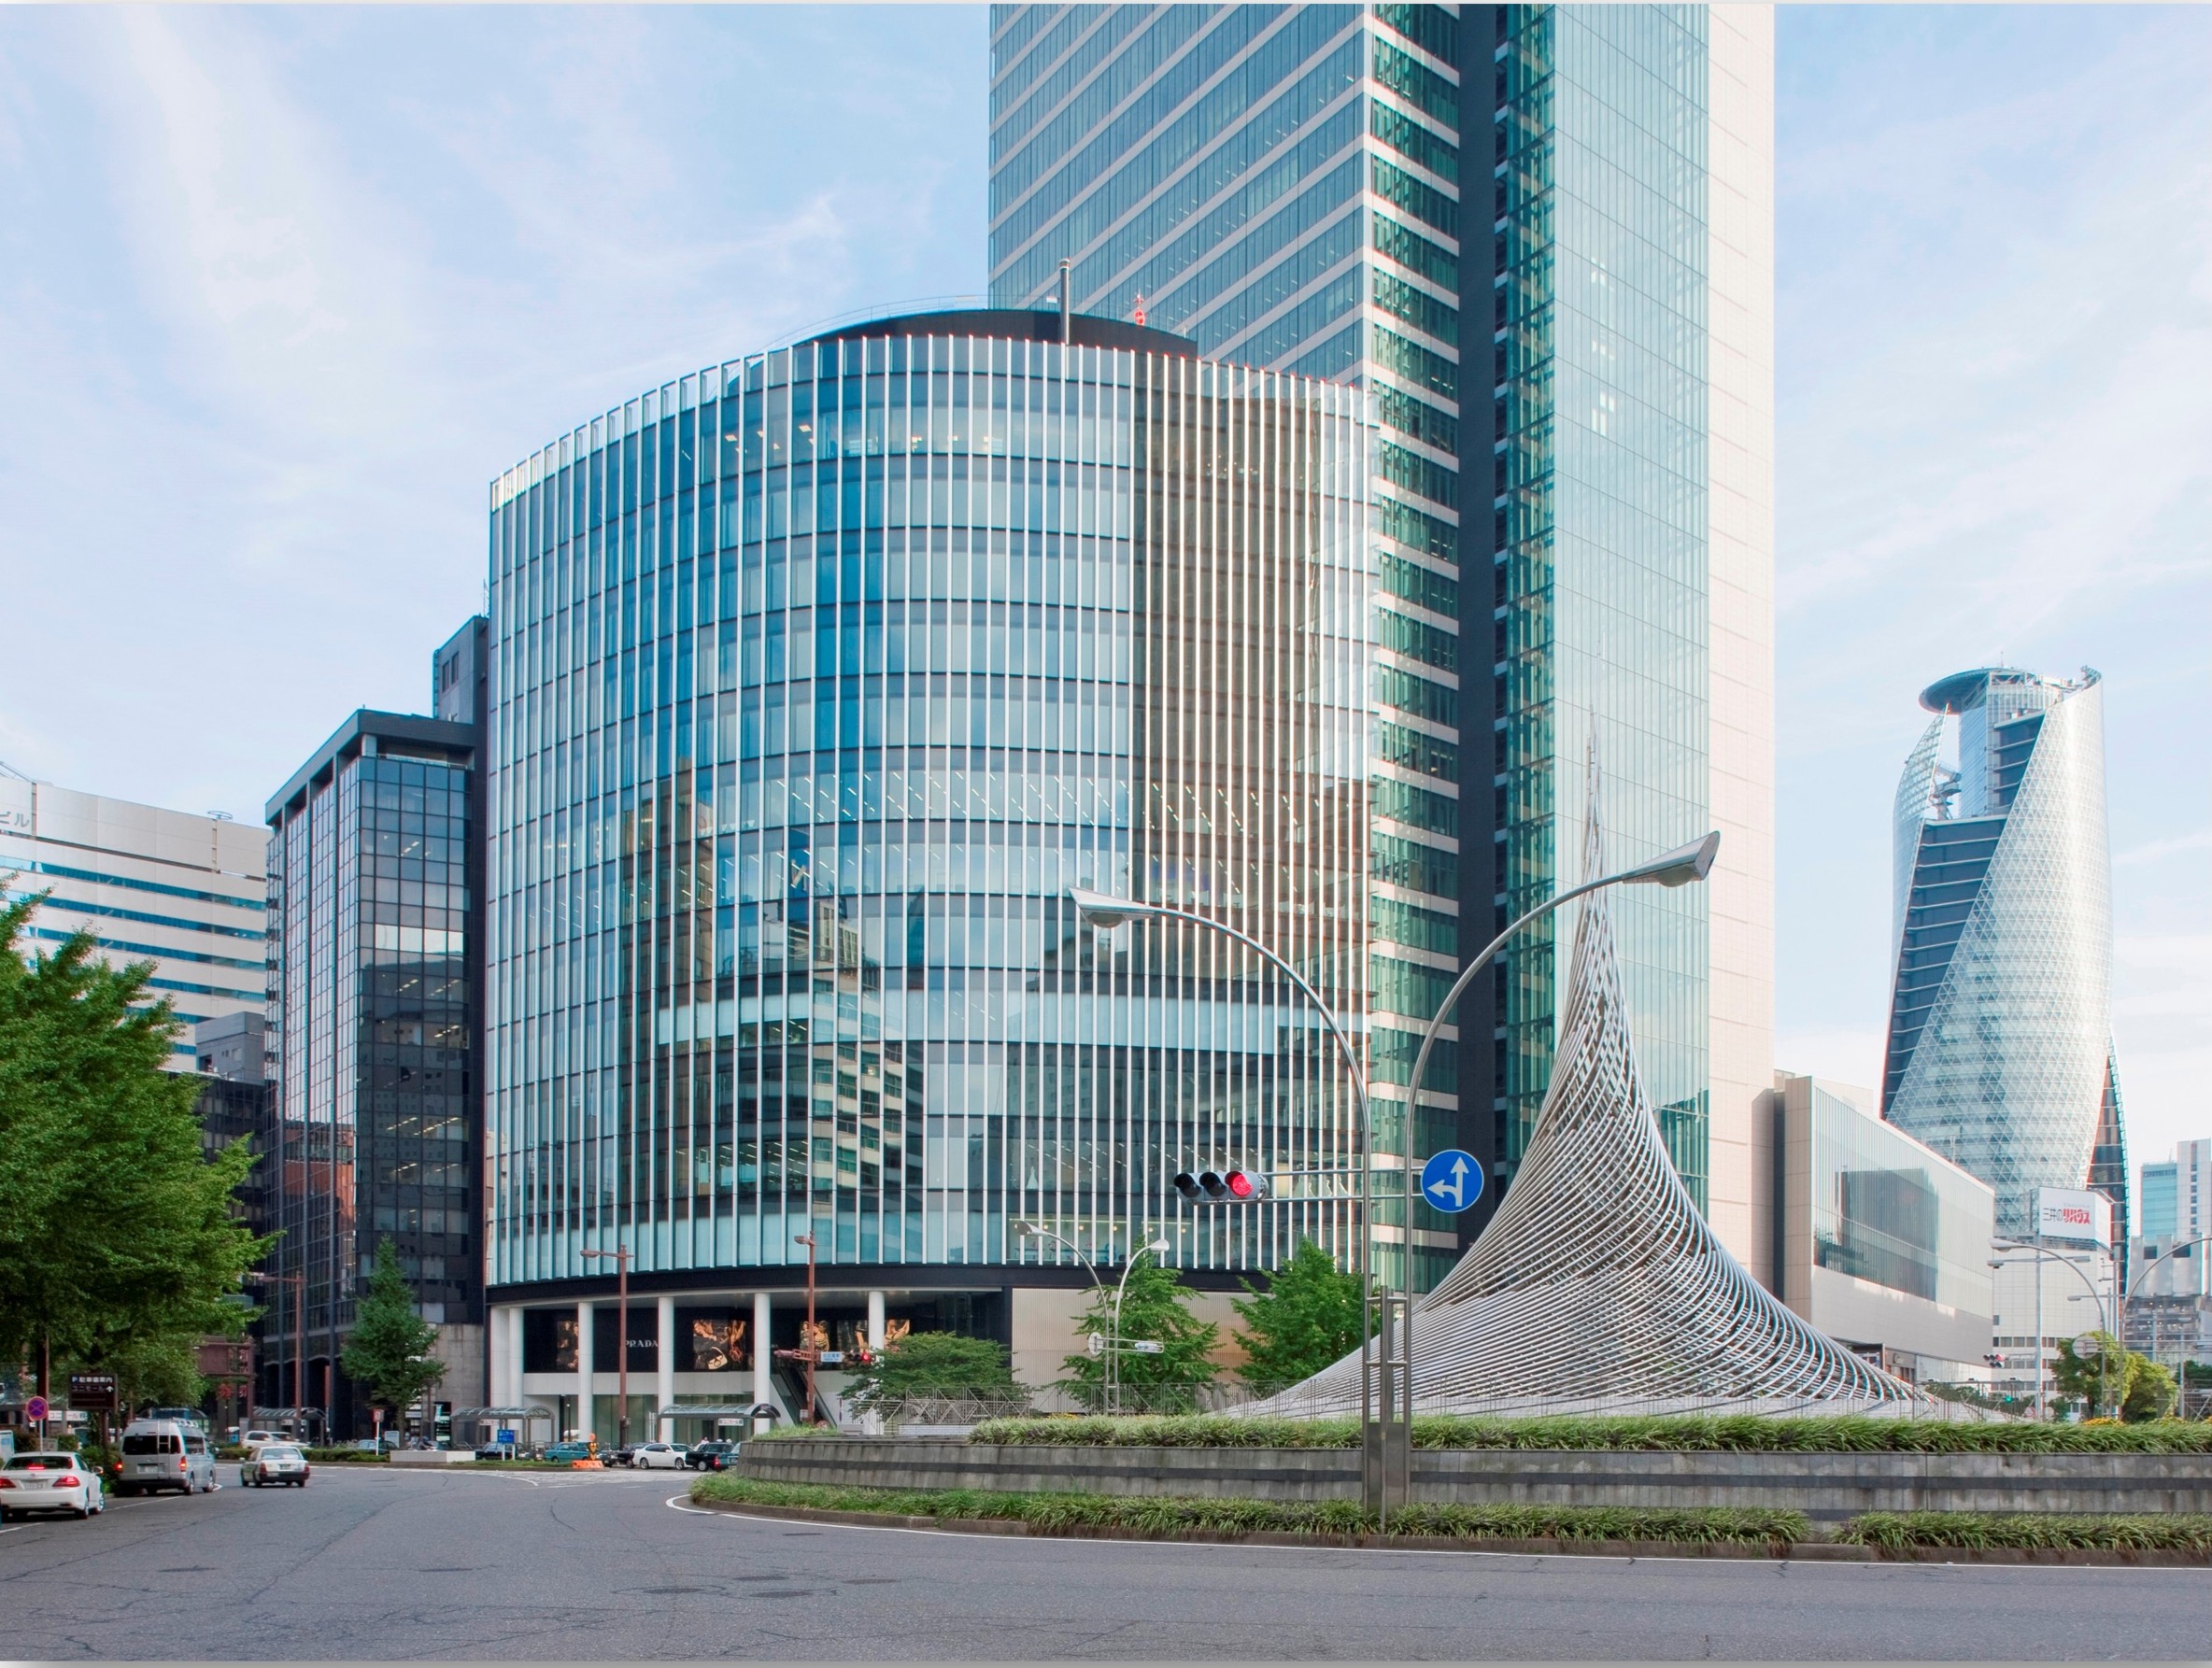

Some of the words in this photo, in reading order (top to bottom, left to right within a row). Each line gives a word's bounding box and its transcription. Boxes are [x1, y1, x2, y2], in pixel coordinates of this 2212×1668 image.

[2043, 1208, 2091, 1224] 三井のリハウス
[625, 1339, 659, 1348] PRADA
